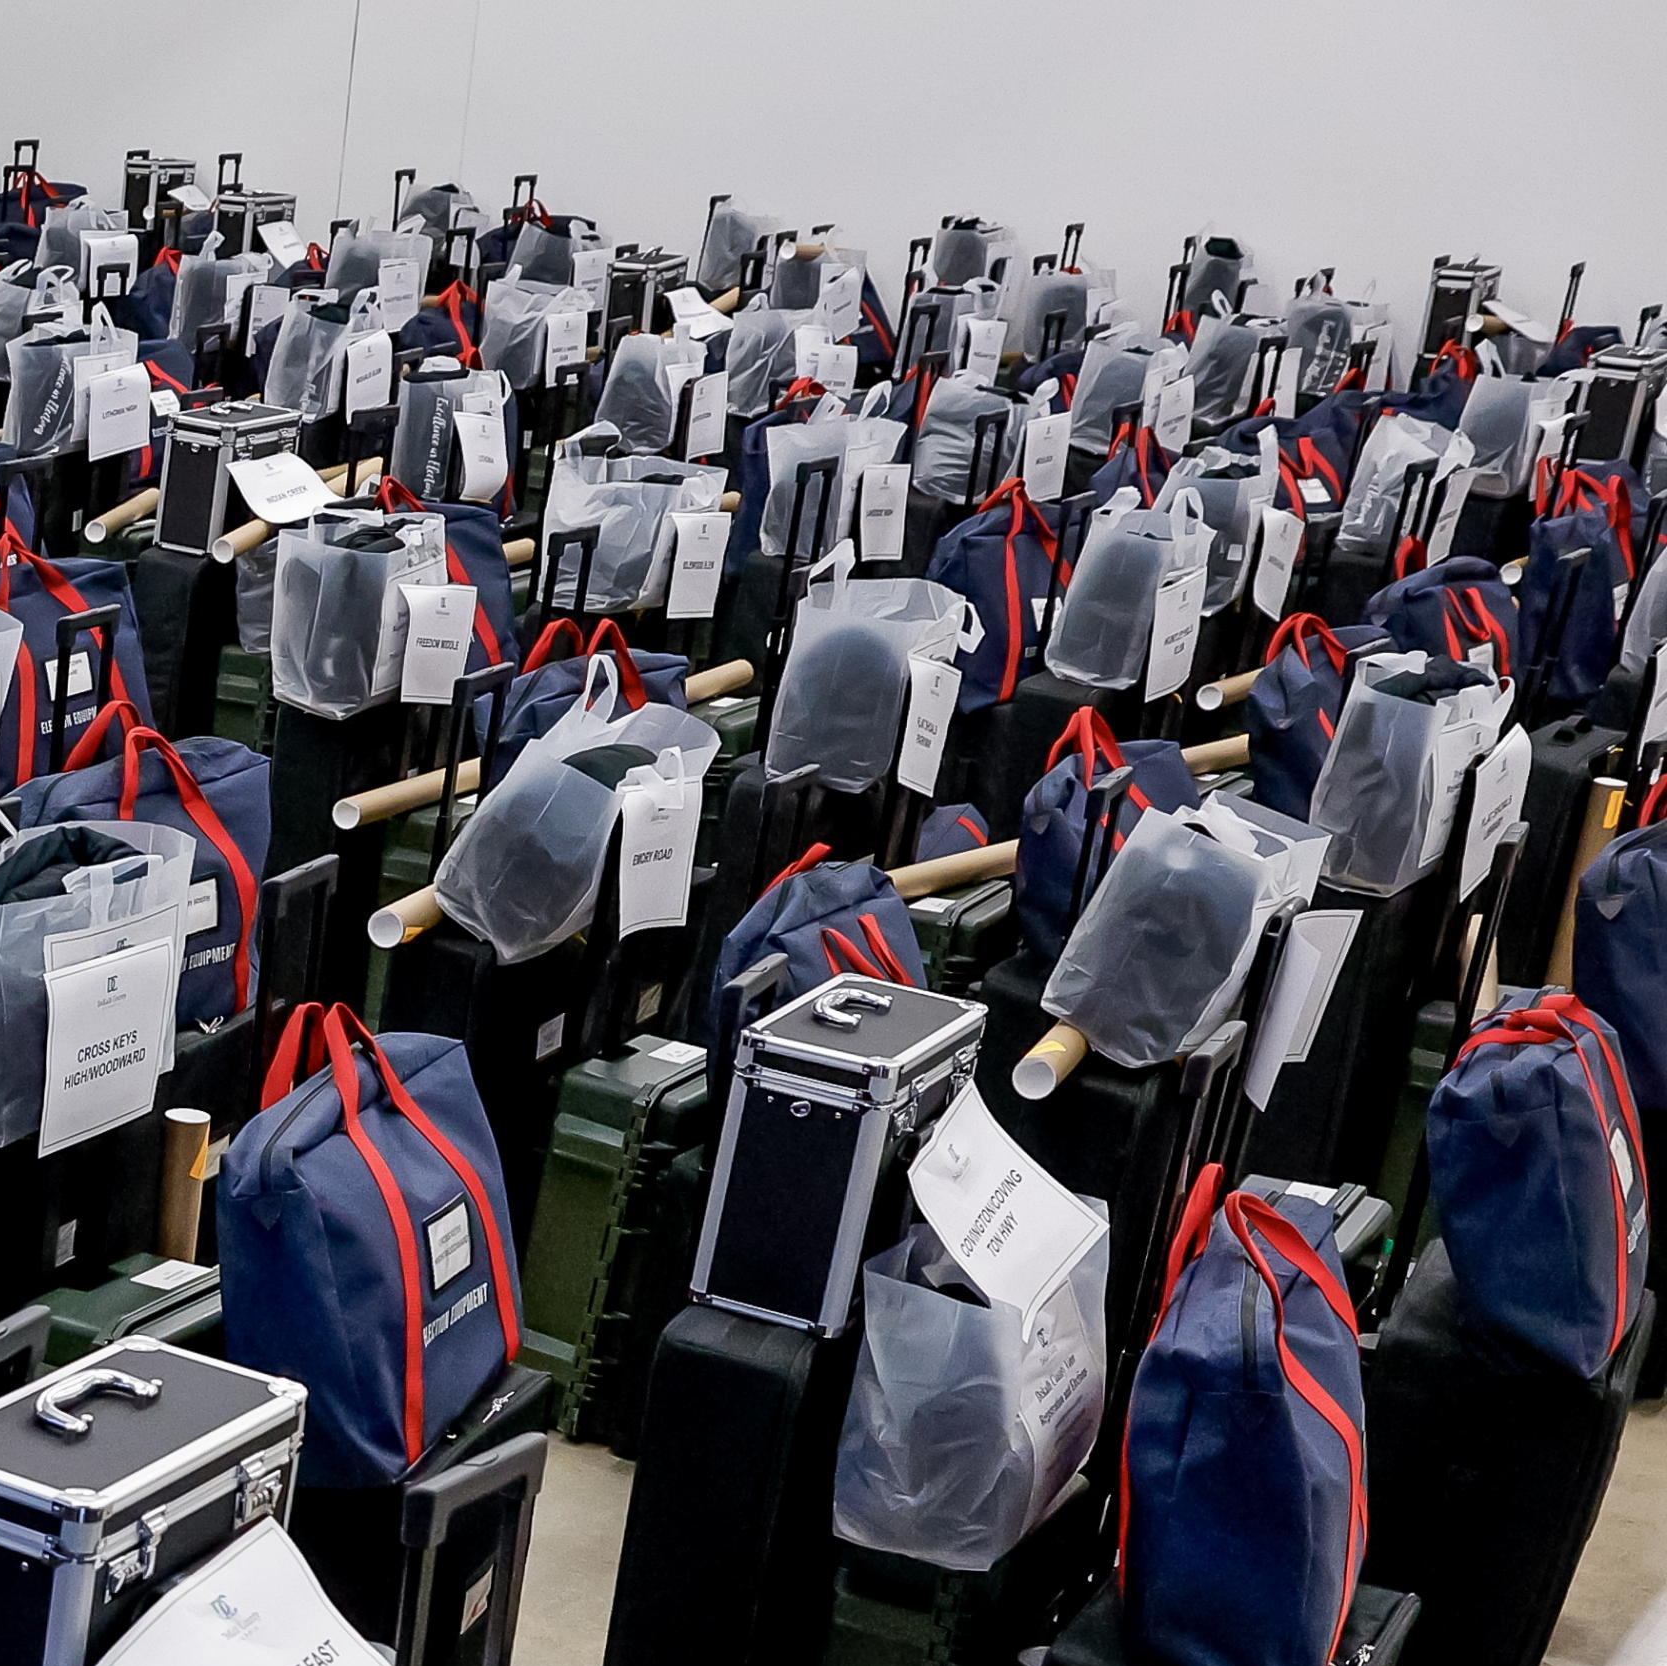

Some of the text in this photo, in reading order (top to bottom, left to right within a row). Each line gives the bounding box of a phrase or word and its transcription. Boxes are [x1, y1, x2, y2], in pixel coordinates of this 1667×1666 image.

[632, 847, 673, 866] EMORY ROAD
[188, 943, 236, 971] EQUIPMENT
[77, 1029, 138, 1065] CROSS KEYS
[64, 1046, 146, 1091] HIGH/WOODWARD
[998, 1211, 1019, 1244] HWY
